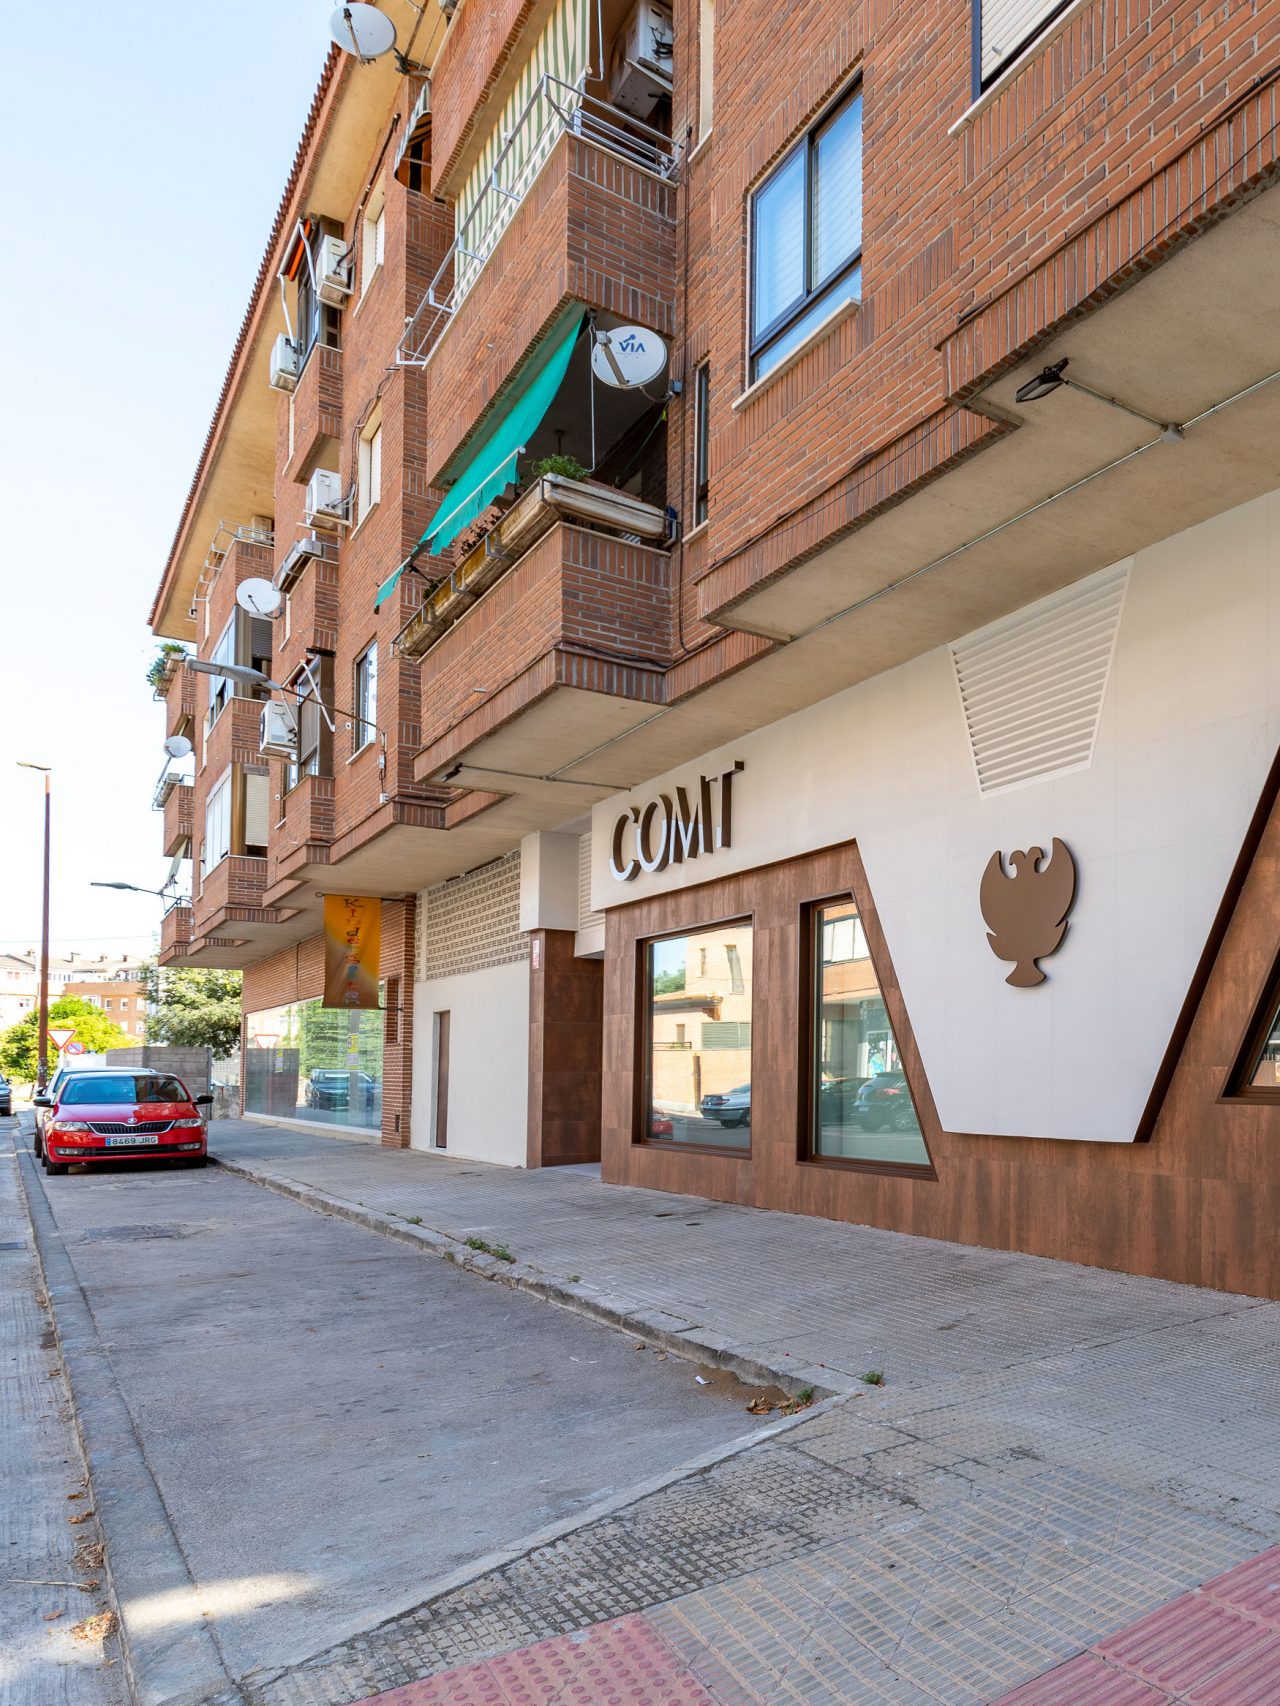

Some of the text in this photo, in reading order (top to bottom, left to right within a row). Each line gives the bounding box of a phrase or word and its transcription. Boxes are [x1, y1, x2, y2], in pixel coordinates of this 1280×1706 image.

[619, 342, 646, 352] VIA
[609, 760, 745, 881] COMT
[112, 1136, 157, 1145] 8469 JRG
